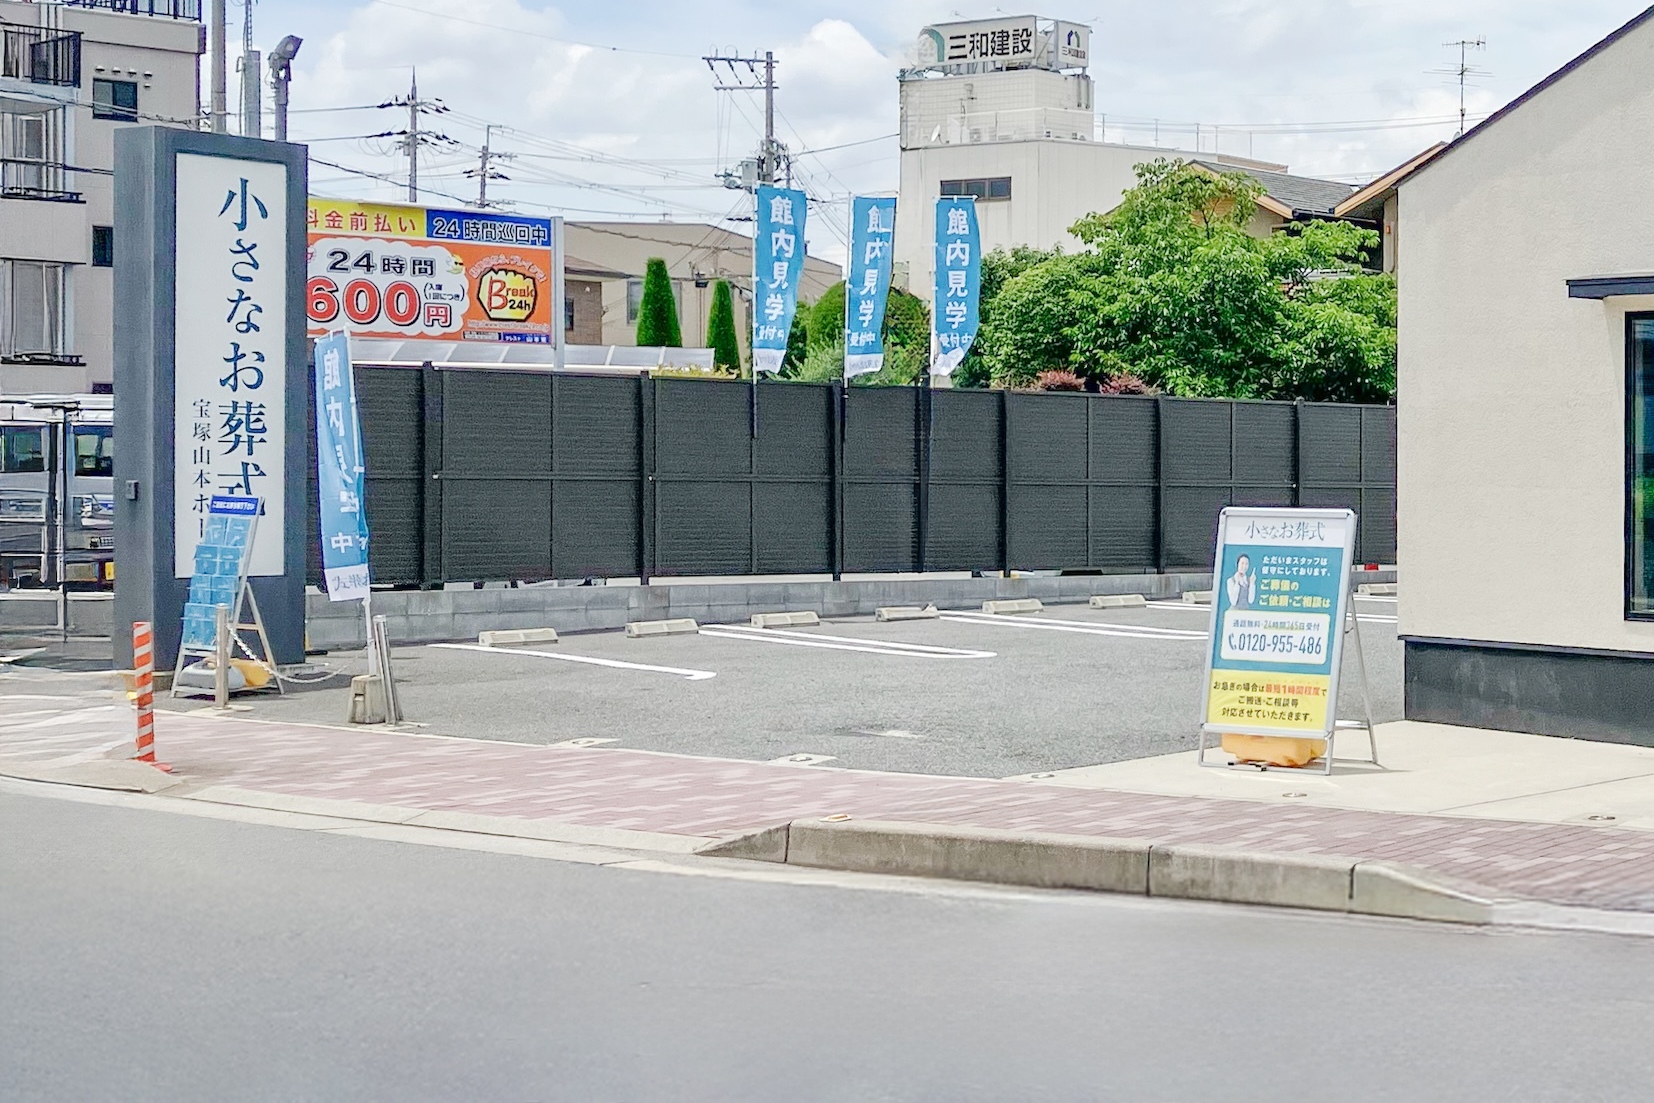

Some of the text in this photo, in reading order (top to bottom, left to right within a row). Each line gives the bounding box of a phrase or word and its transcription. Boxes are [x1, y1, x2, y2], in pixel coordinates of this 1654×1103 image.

[948, 27, 1033, 60] 三和建設
[327, 248, 436, 276] 24時間
[763, 195, 796, 322] 館内見学
[945, 207, 970, 329] 館内見学
[487, 276, 535, 312] Break
[508, 299, 531, 311] 24h
[1245, 520, 1326, 541] 小さなお葬式
[1238, 633, 1322, 655] 0120-955-486
